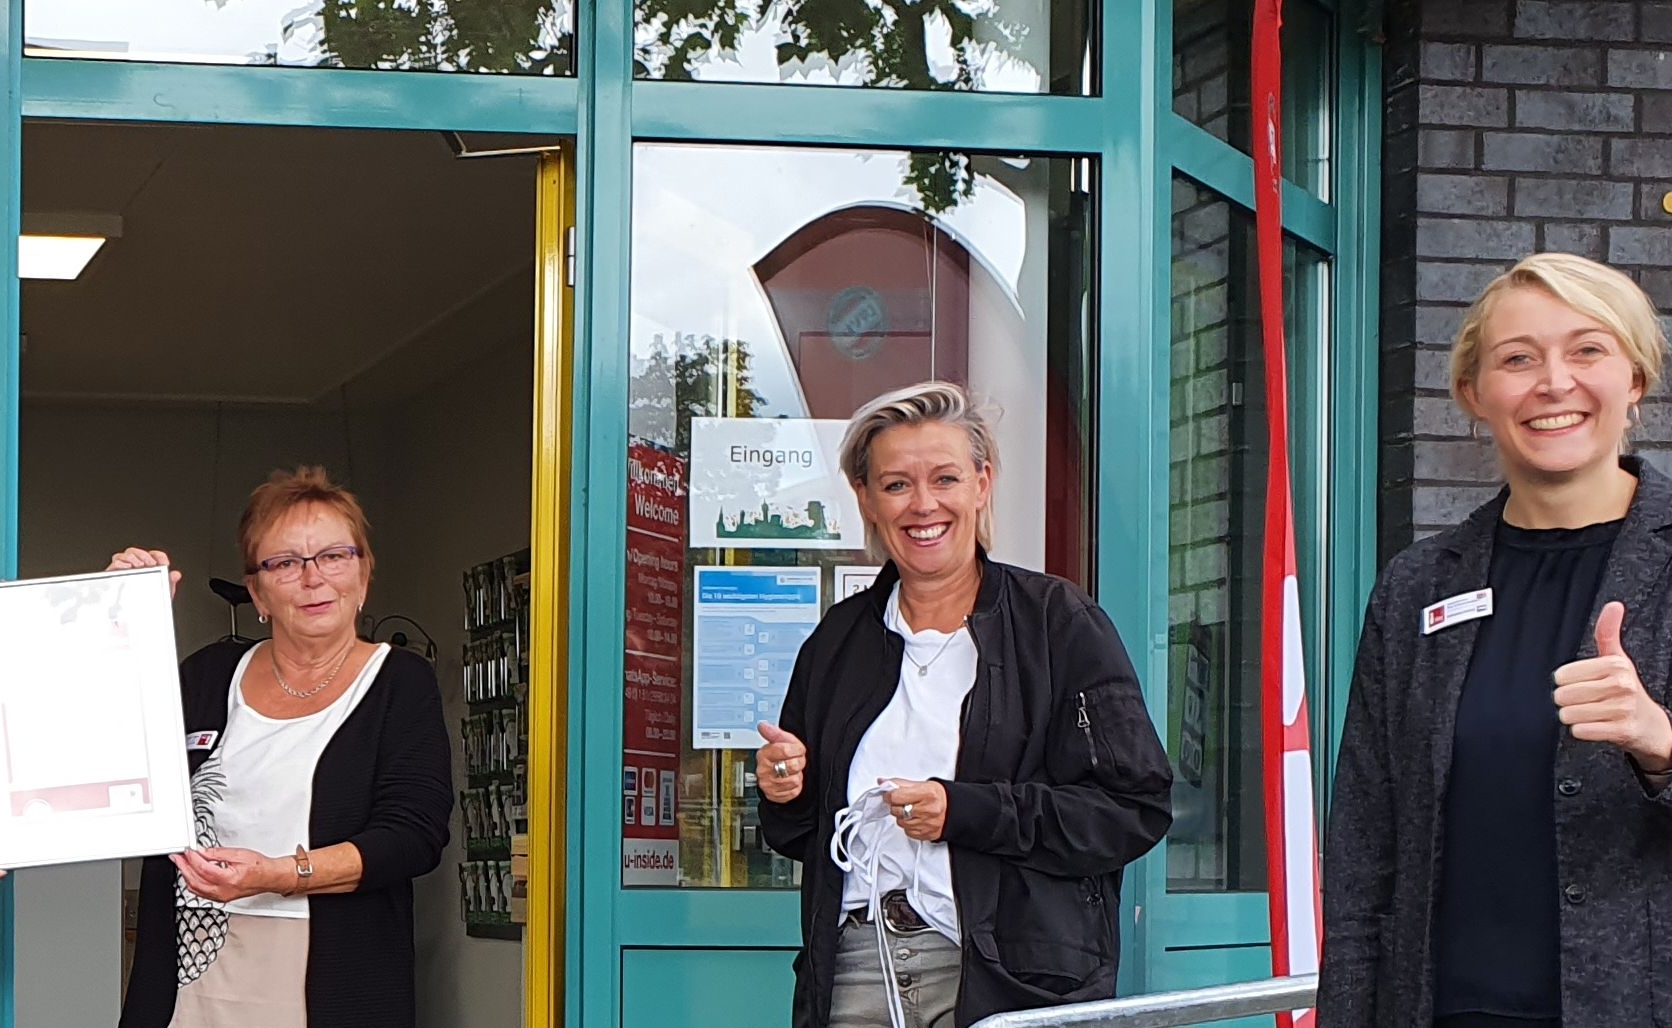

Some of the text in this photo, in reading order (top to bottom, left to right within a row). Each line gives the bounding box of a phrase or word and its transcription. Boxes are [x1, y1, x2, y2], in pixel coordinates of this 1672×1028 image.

[730, 445, 813, 468] Eingang
[634, 493, 679, 525] Welcome
[625, 848, 675, 870] u-inside.de
